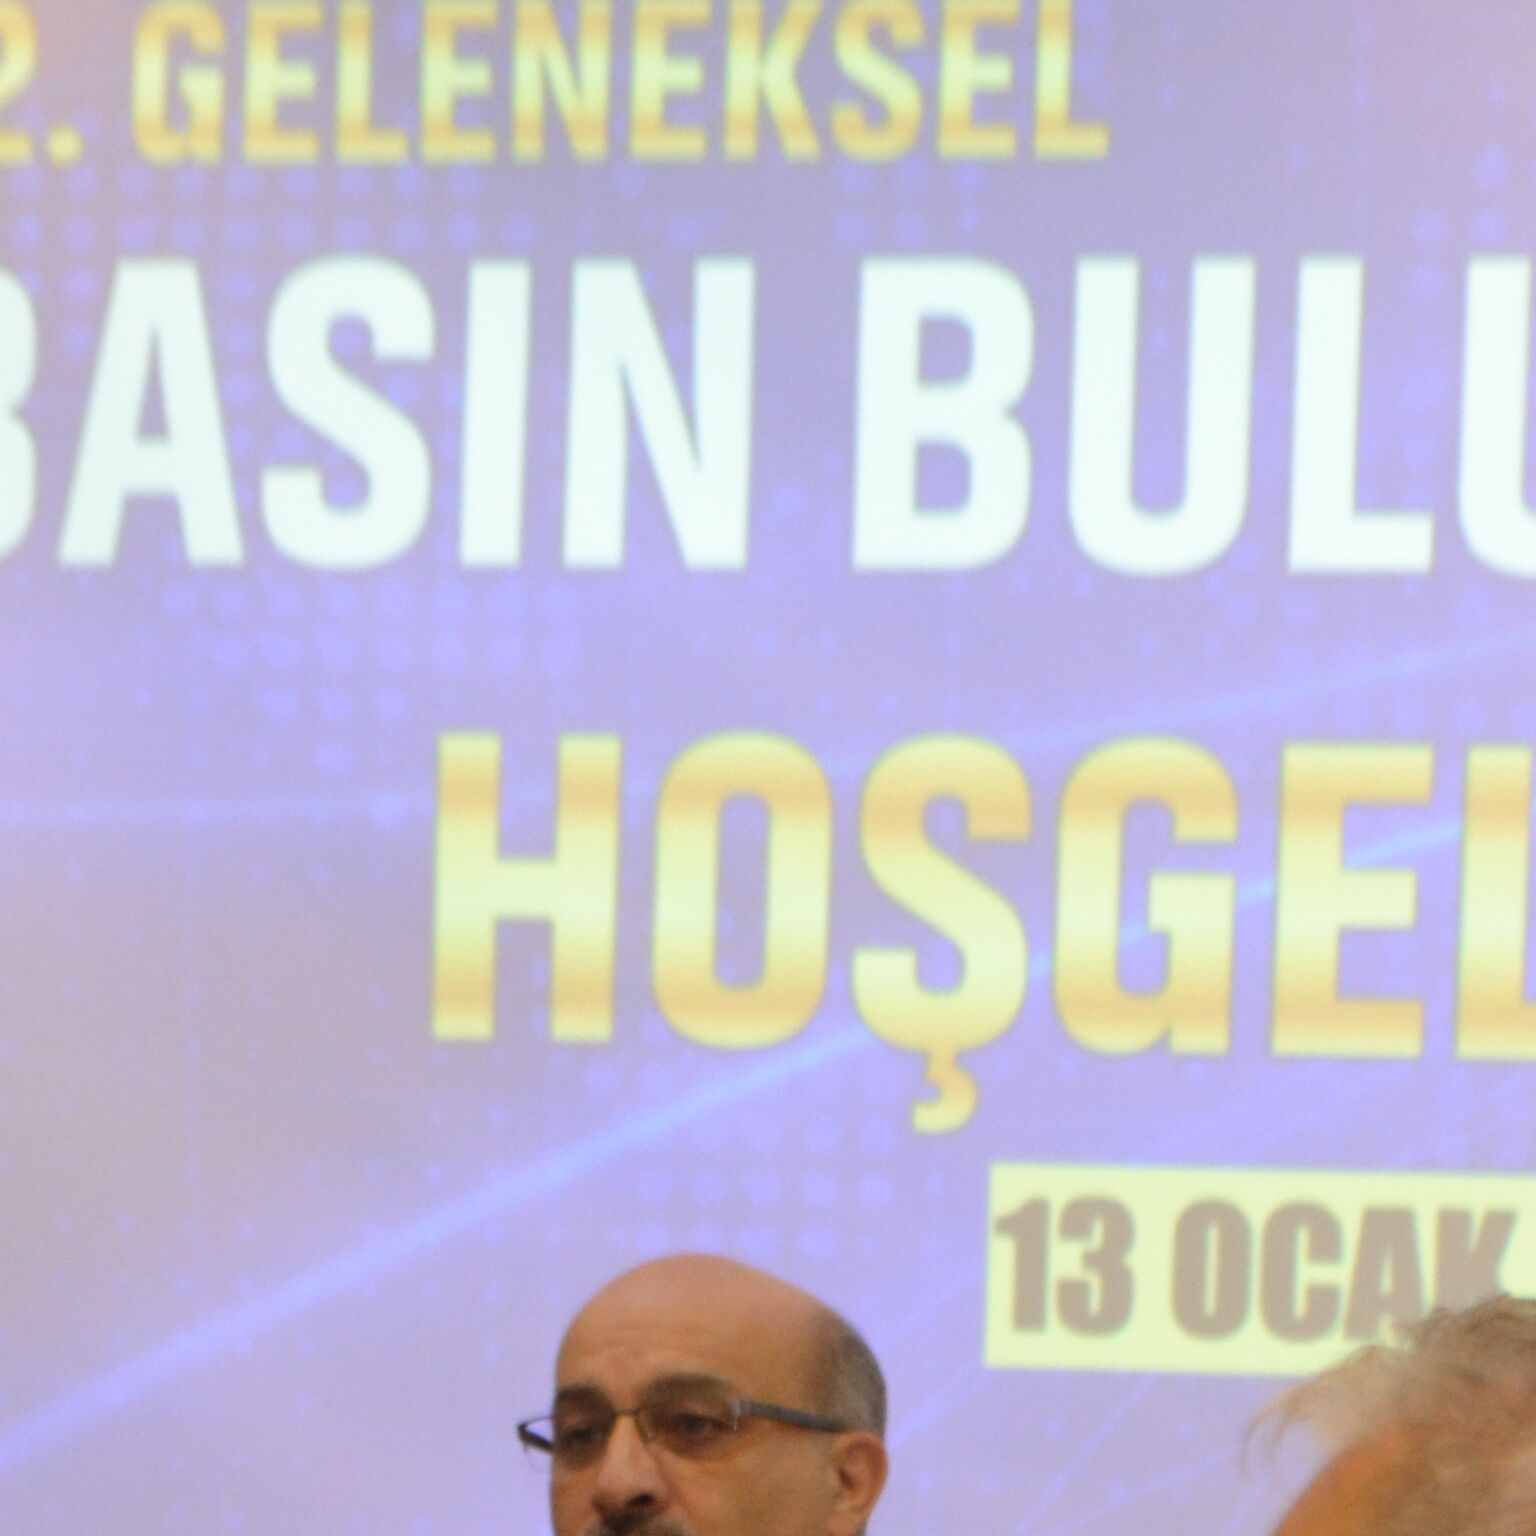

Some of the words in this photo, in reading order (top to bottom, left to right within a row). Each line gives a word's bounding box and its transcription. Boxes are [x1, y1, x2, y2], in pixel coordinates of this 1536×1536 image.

[130, 0, 1110, 165] GELENEKSEL
[994, 1195, 1135, 1338] 13
[1170, 1198, 1518, 1342] OCAK
